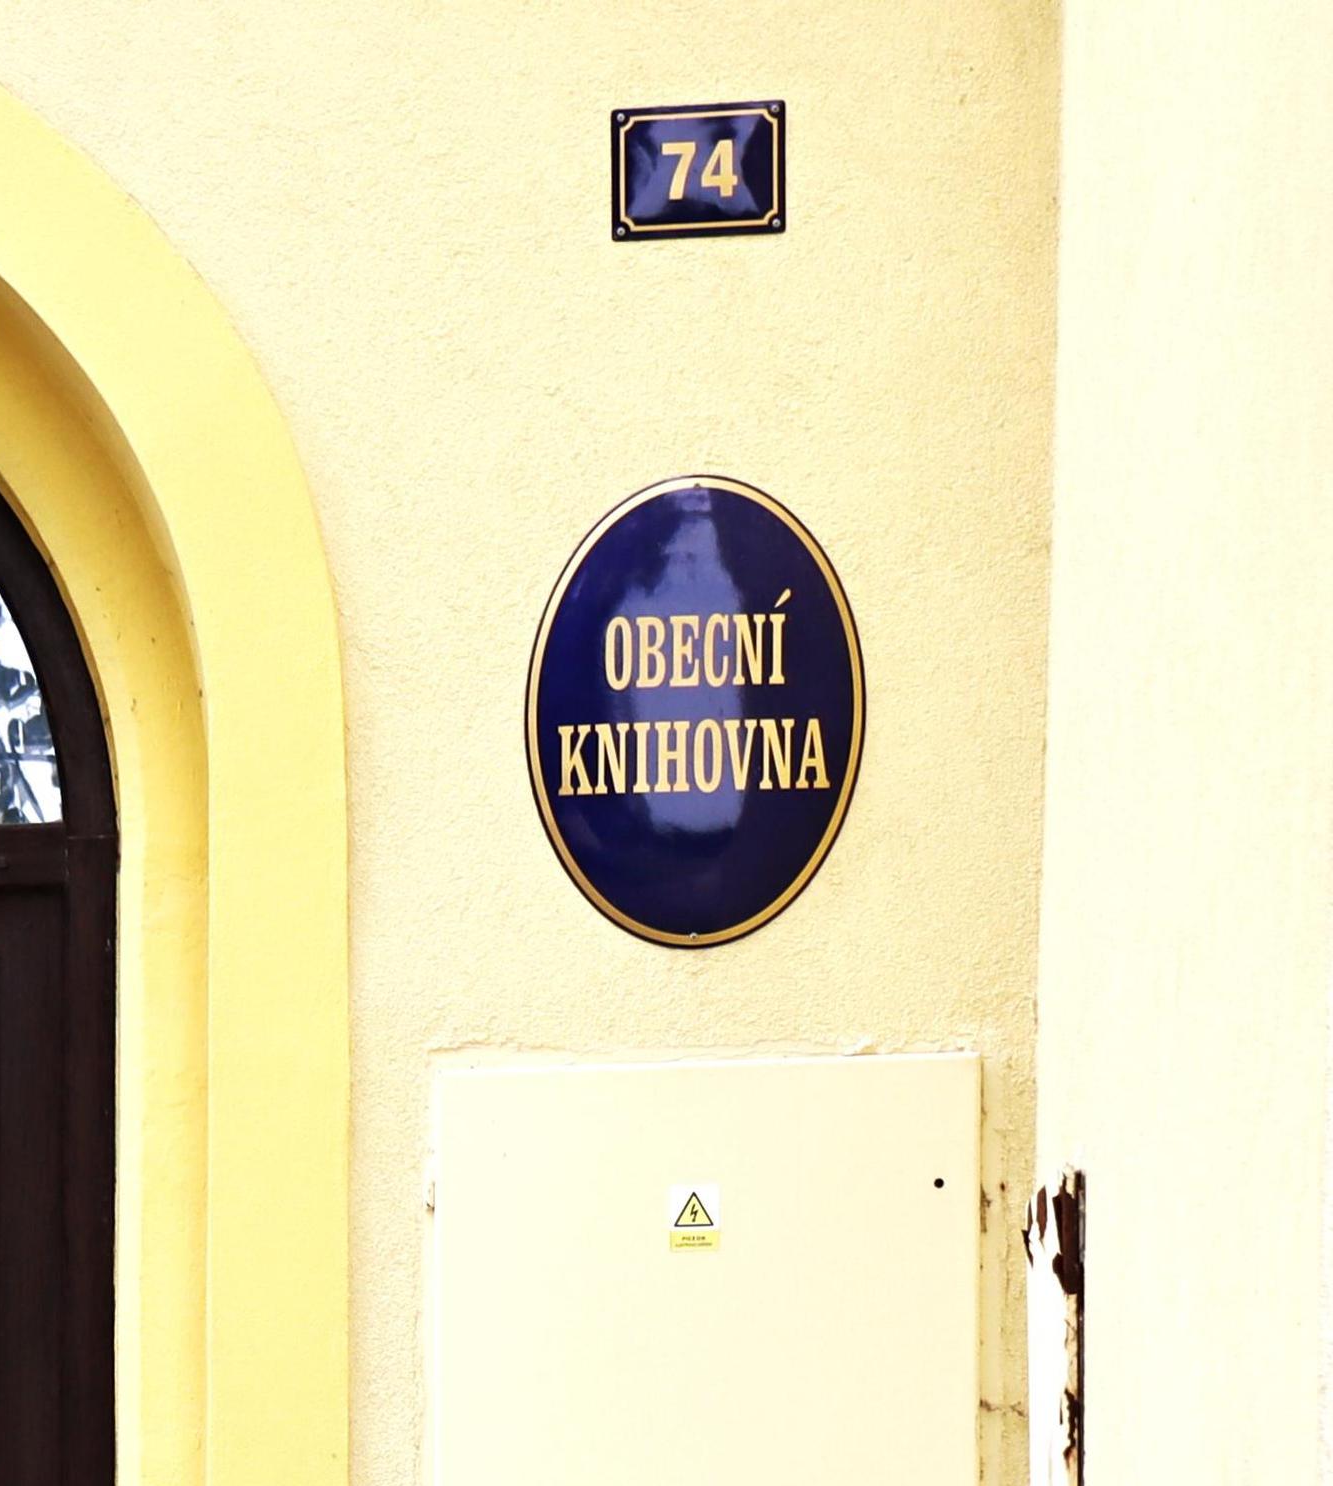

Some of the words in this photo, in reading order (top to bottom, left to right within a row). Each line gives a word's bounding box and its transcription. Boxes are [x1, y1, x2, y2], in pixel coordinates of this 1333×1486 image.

[661, 139, 738, 200] 74
[604, 588, 792, 691] OBECNÍ
[557, 717, 831, 797] KNIHOVNA
